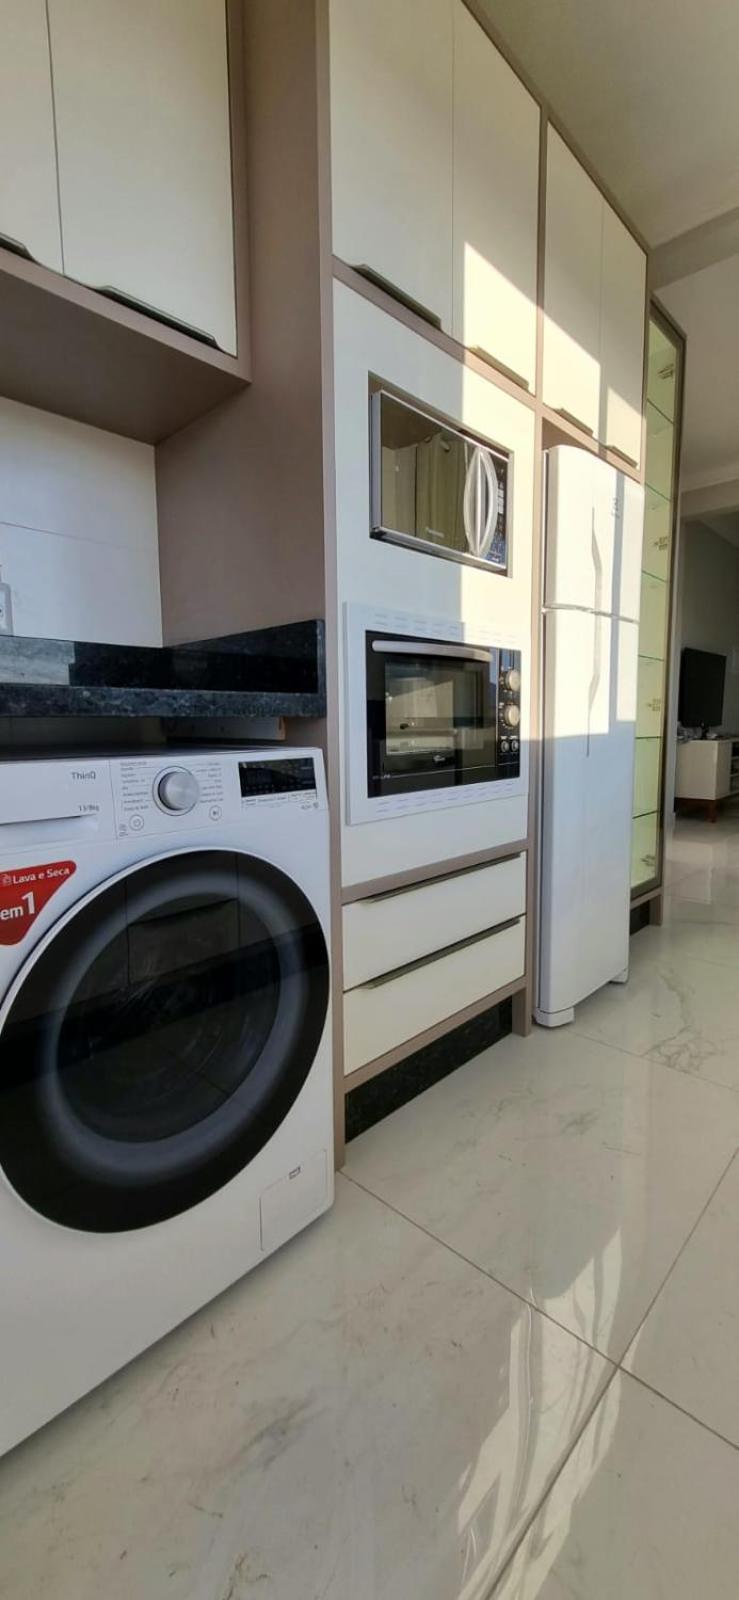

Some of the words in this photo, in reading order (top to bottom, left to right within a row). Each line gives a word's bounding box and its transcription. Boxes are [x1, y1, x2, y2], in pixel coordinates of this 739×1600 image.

[71, 770, 97, 781] ThinQ
[12, 873, 36, 885] Lava
[38, 872, 45, 880] e
[46, 867, 70, 878] Seca
[0, 905, 24, 920] em
[21, 890, 35, 915] 1
